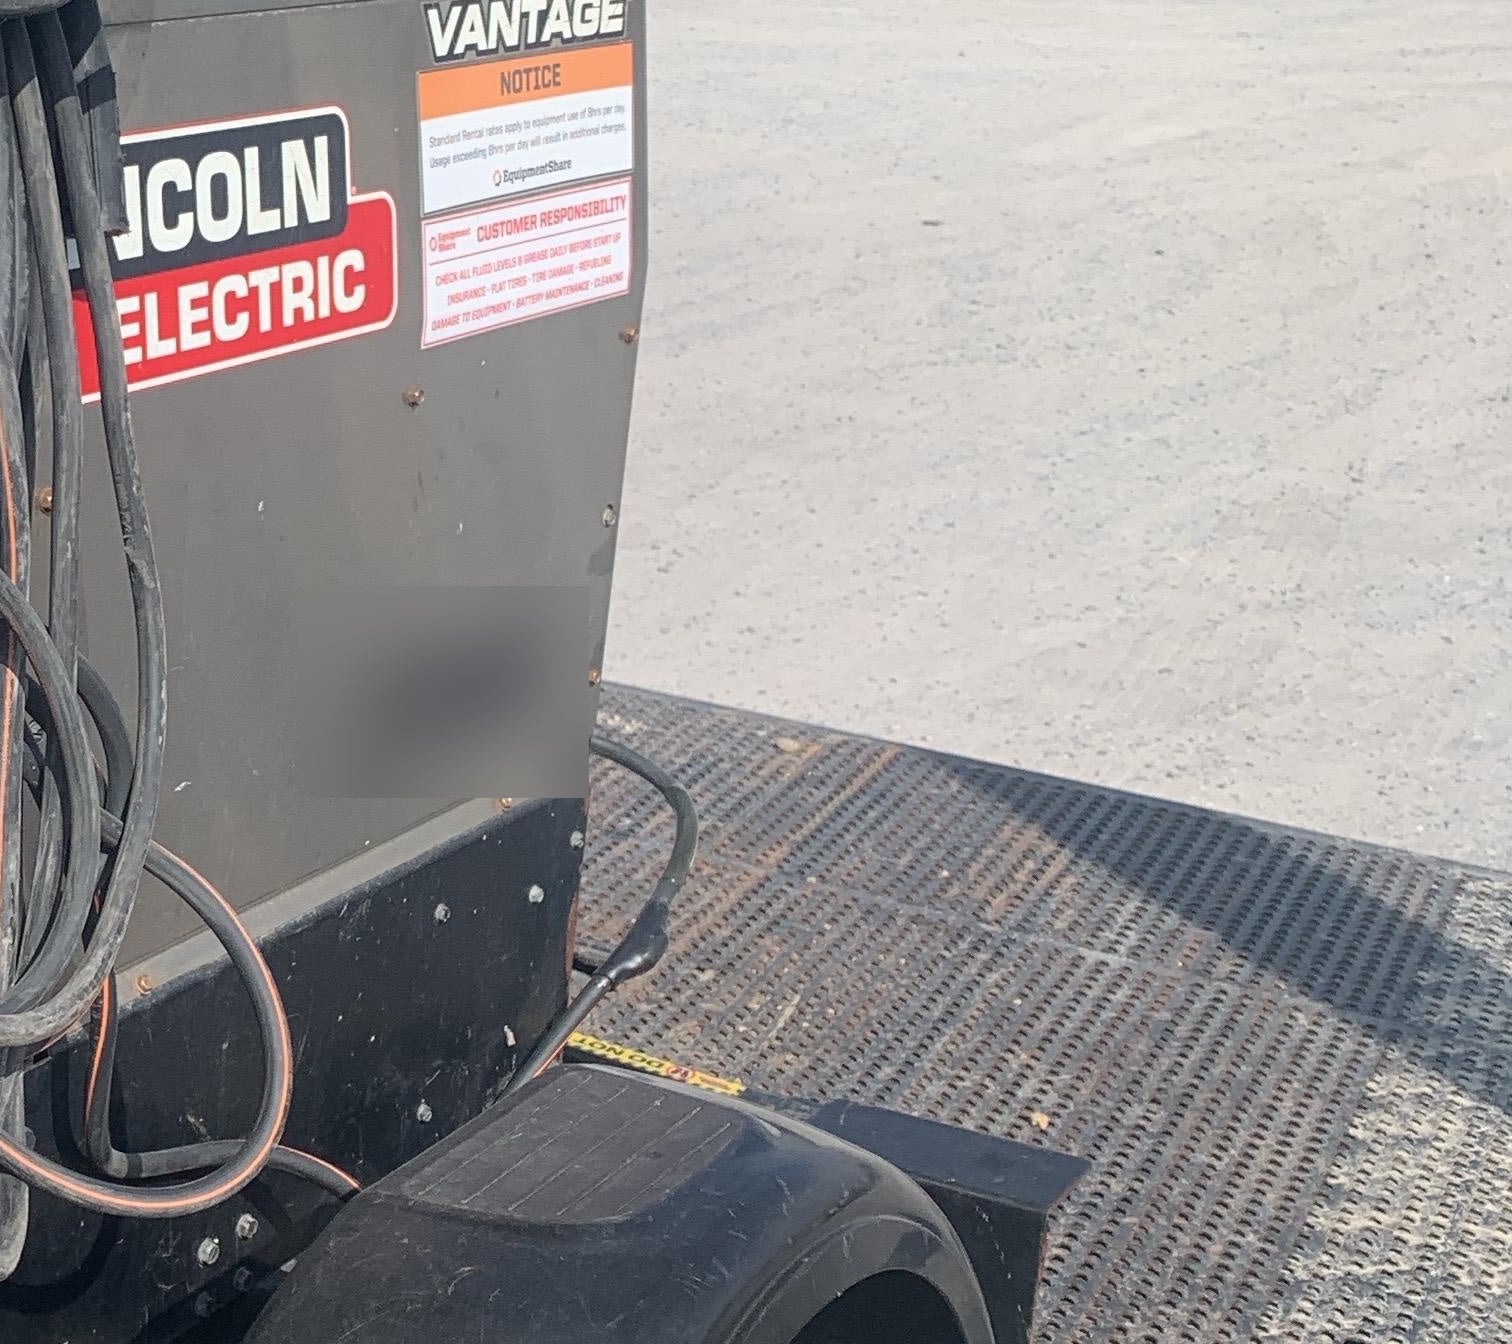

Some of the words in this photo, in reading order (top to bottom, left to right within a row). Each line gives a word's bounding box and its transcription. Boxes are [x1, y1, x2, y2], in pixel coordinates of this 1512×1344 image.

[500, 62, 561, 96] NOTICE
[429, 129, 461, 148] Standard
[462, 126, 484, 142] Rental
[486, 123, 504, 137] rates
[505, 120, 523, 137] apply
[524, 119, 531, 130] to
[532, 112, 567, 131] equipment
[567, 110, 579, 121] use
[580, 107, 586, 119] of
[603, 105, 614, 118] per
[429, 154, 451, 169] Usage
[453, 145, 487, 163] exceeding
[505, 142, 516, 156] per
[517, 138, 529, 152] day
[530, 135, 541, 147] will
[542, 131, 561, 145] result
[561, 130, 569, 141] in
[569, 125, 600, 140] additional
[503, 158, 573, 184] EquipmentShare
[476, 214, 538, 243] CUSTOMER
[540, 194, 627, 228] RESPONSIBILITY
[435, 272, 458, 287] CHECK
[459, 269, 472, 282] ALL
[493, 258, 517, 273] LEVELS
[524, 251, 549, 265] GREASE
[549, 245, 568, 259] DAILY
[569, 239, 592, 254] BEFORE
[593, 234, 612, 249] START
[613, 232, 622, 244] UP
[432, 315, 460, 331] DAMAGE
[462, 311, 471, 323] TO
[471, 300, 512, 321] EQUIPMENT
[516, 292, 544, 310] BATTERY
[545, 281, 590, 301] MAINTENANCE
[593, 271, 624, 289] CLEANING
[447, 287, 487, 306] INSURANCE
[491, 281, 506, 295] FLAT
[532, 270, 547, 283] TIRE
[548, 263, 575, 280] DAMAGE
[114, 249, 366, 366] ELECTRIC
